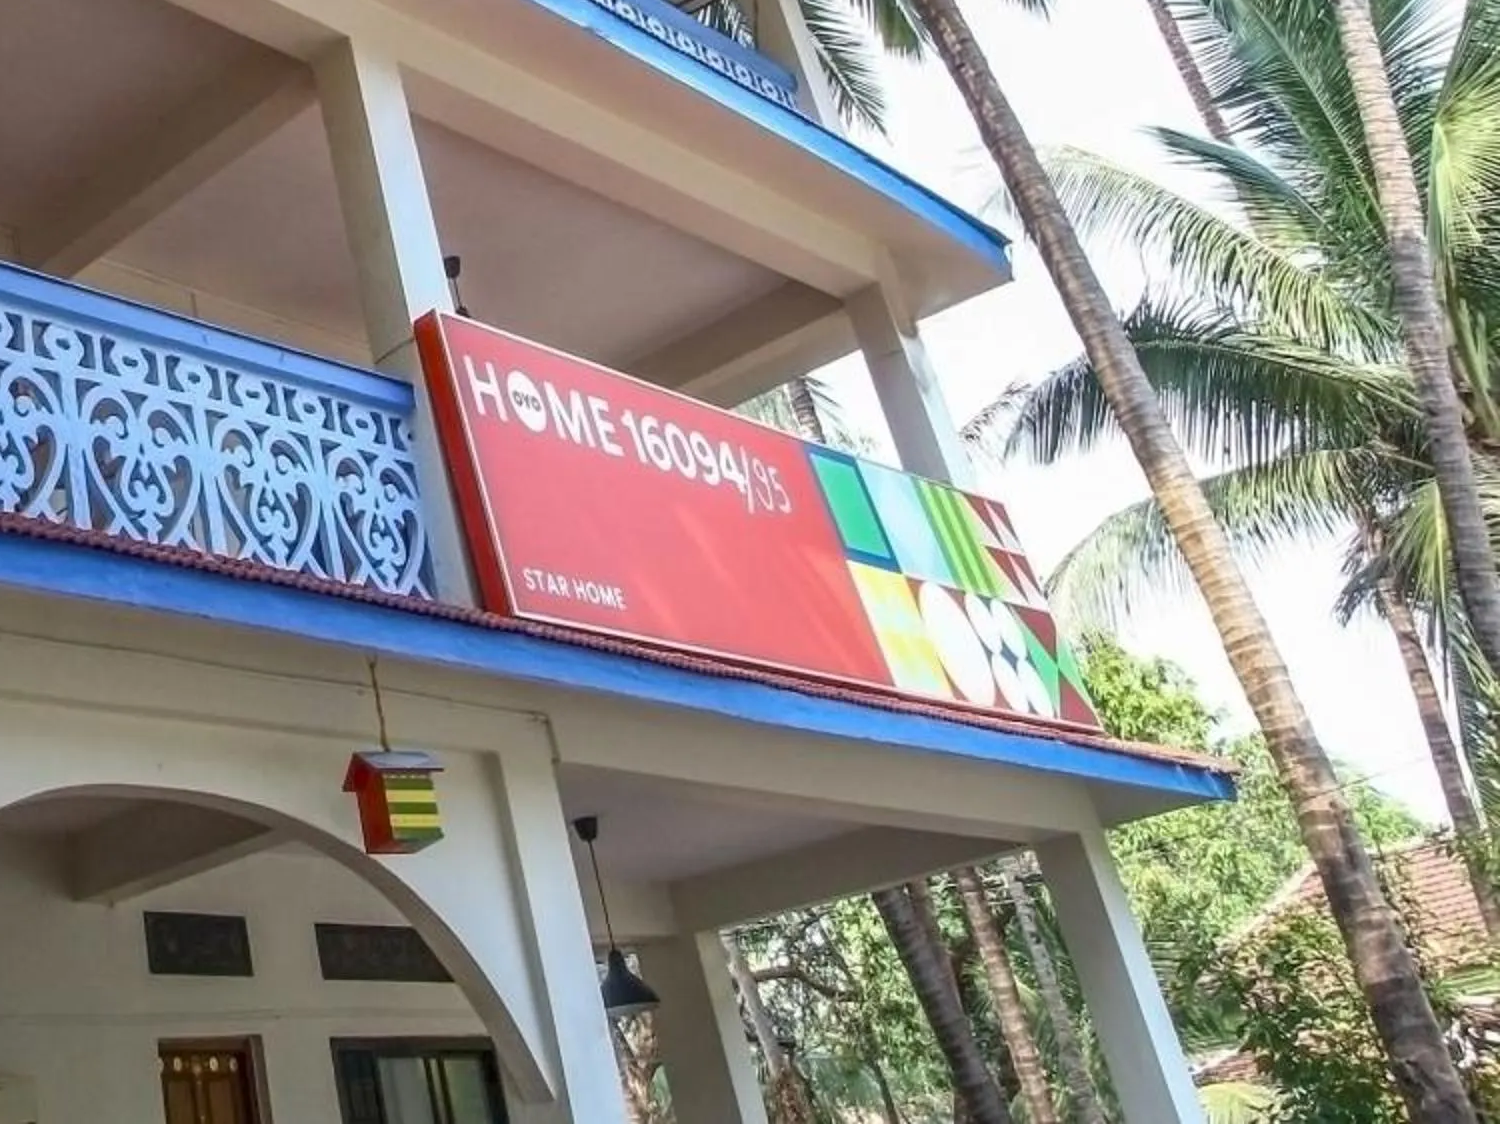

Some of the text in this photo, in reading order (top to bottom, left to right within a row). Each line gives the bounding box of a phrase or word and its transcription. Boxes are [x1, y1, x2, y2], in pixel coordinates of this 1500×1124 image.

[511, 389, 542, 413] OYO
[522, 567, 628, 611] STAR HOME
